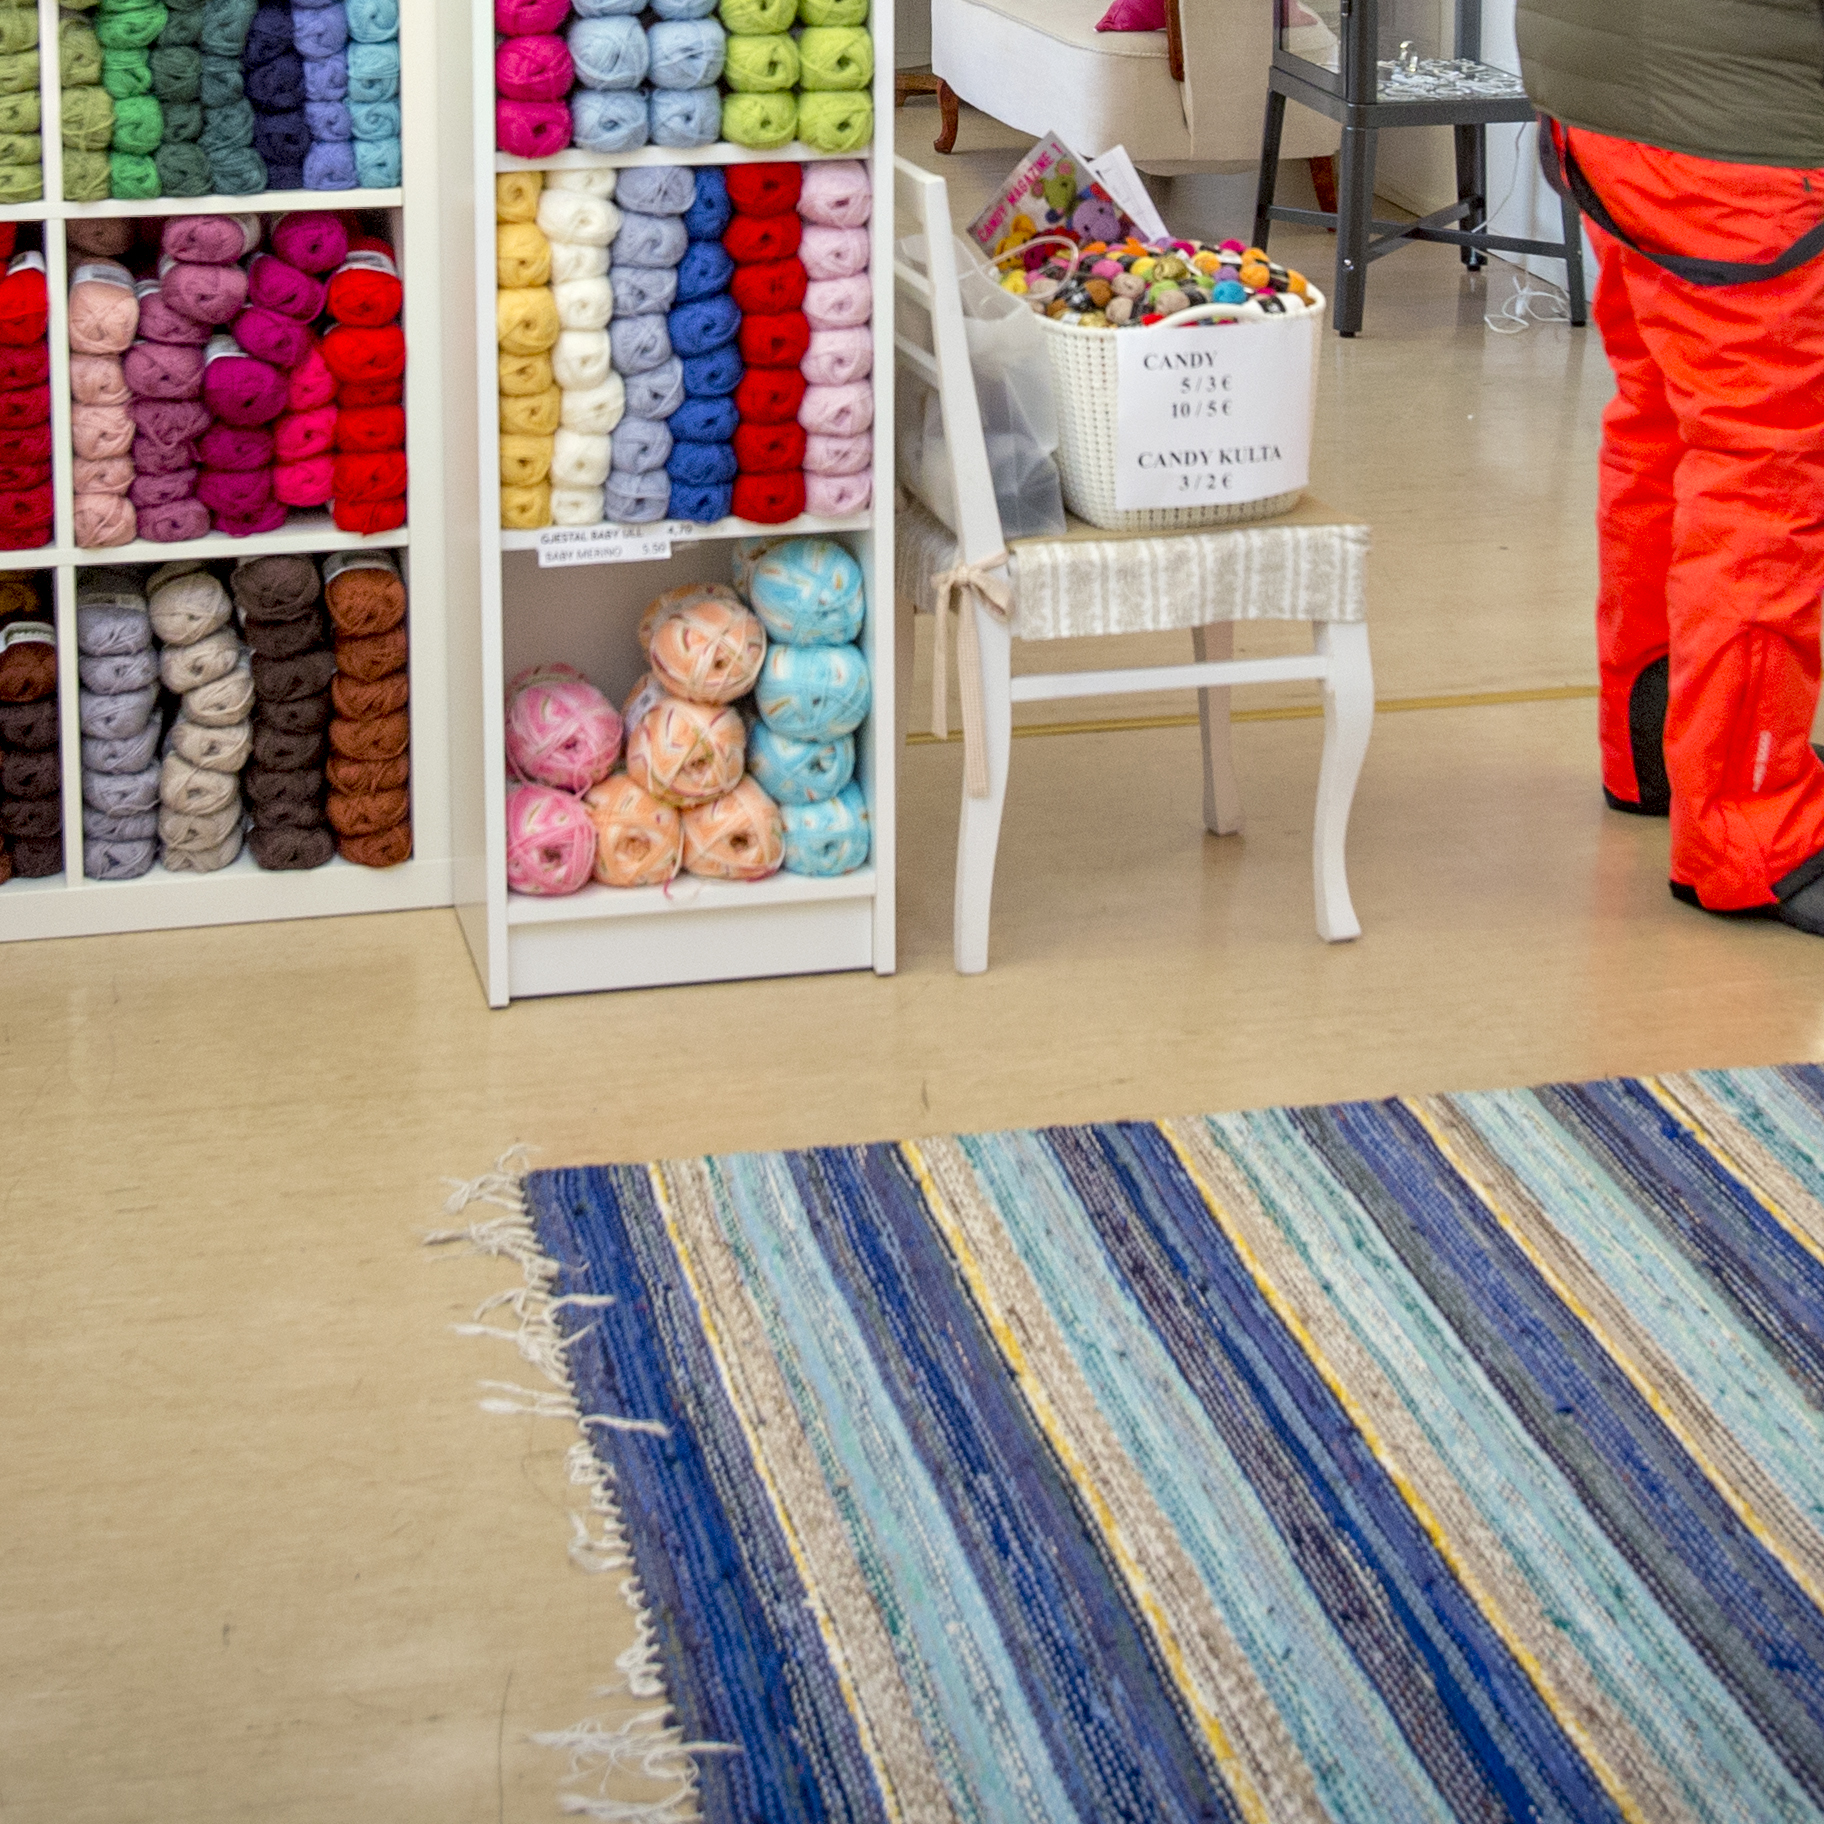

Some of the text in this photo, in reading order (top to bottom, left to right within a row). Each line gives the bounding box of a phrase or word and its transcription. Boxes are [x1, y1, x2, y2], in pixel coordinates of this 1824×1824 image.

[977, 204, 1008, 245] CANDY
[1006, 150, 1055, 209] MAGAZINE
[1143, 350, 1218, 371] CANDY
[1138, 444, 1283, 470] CANDY KULTA
[540, 530, 587, 545] GJESTAL
[590, 528, 618, 540] BABY
[545, 550, 574, 564] BABY
[578, 545, 623, 560] MERINO
